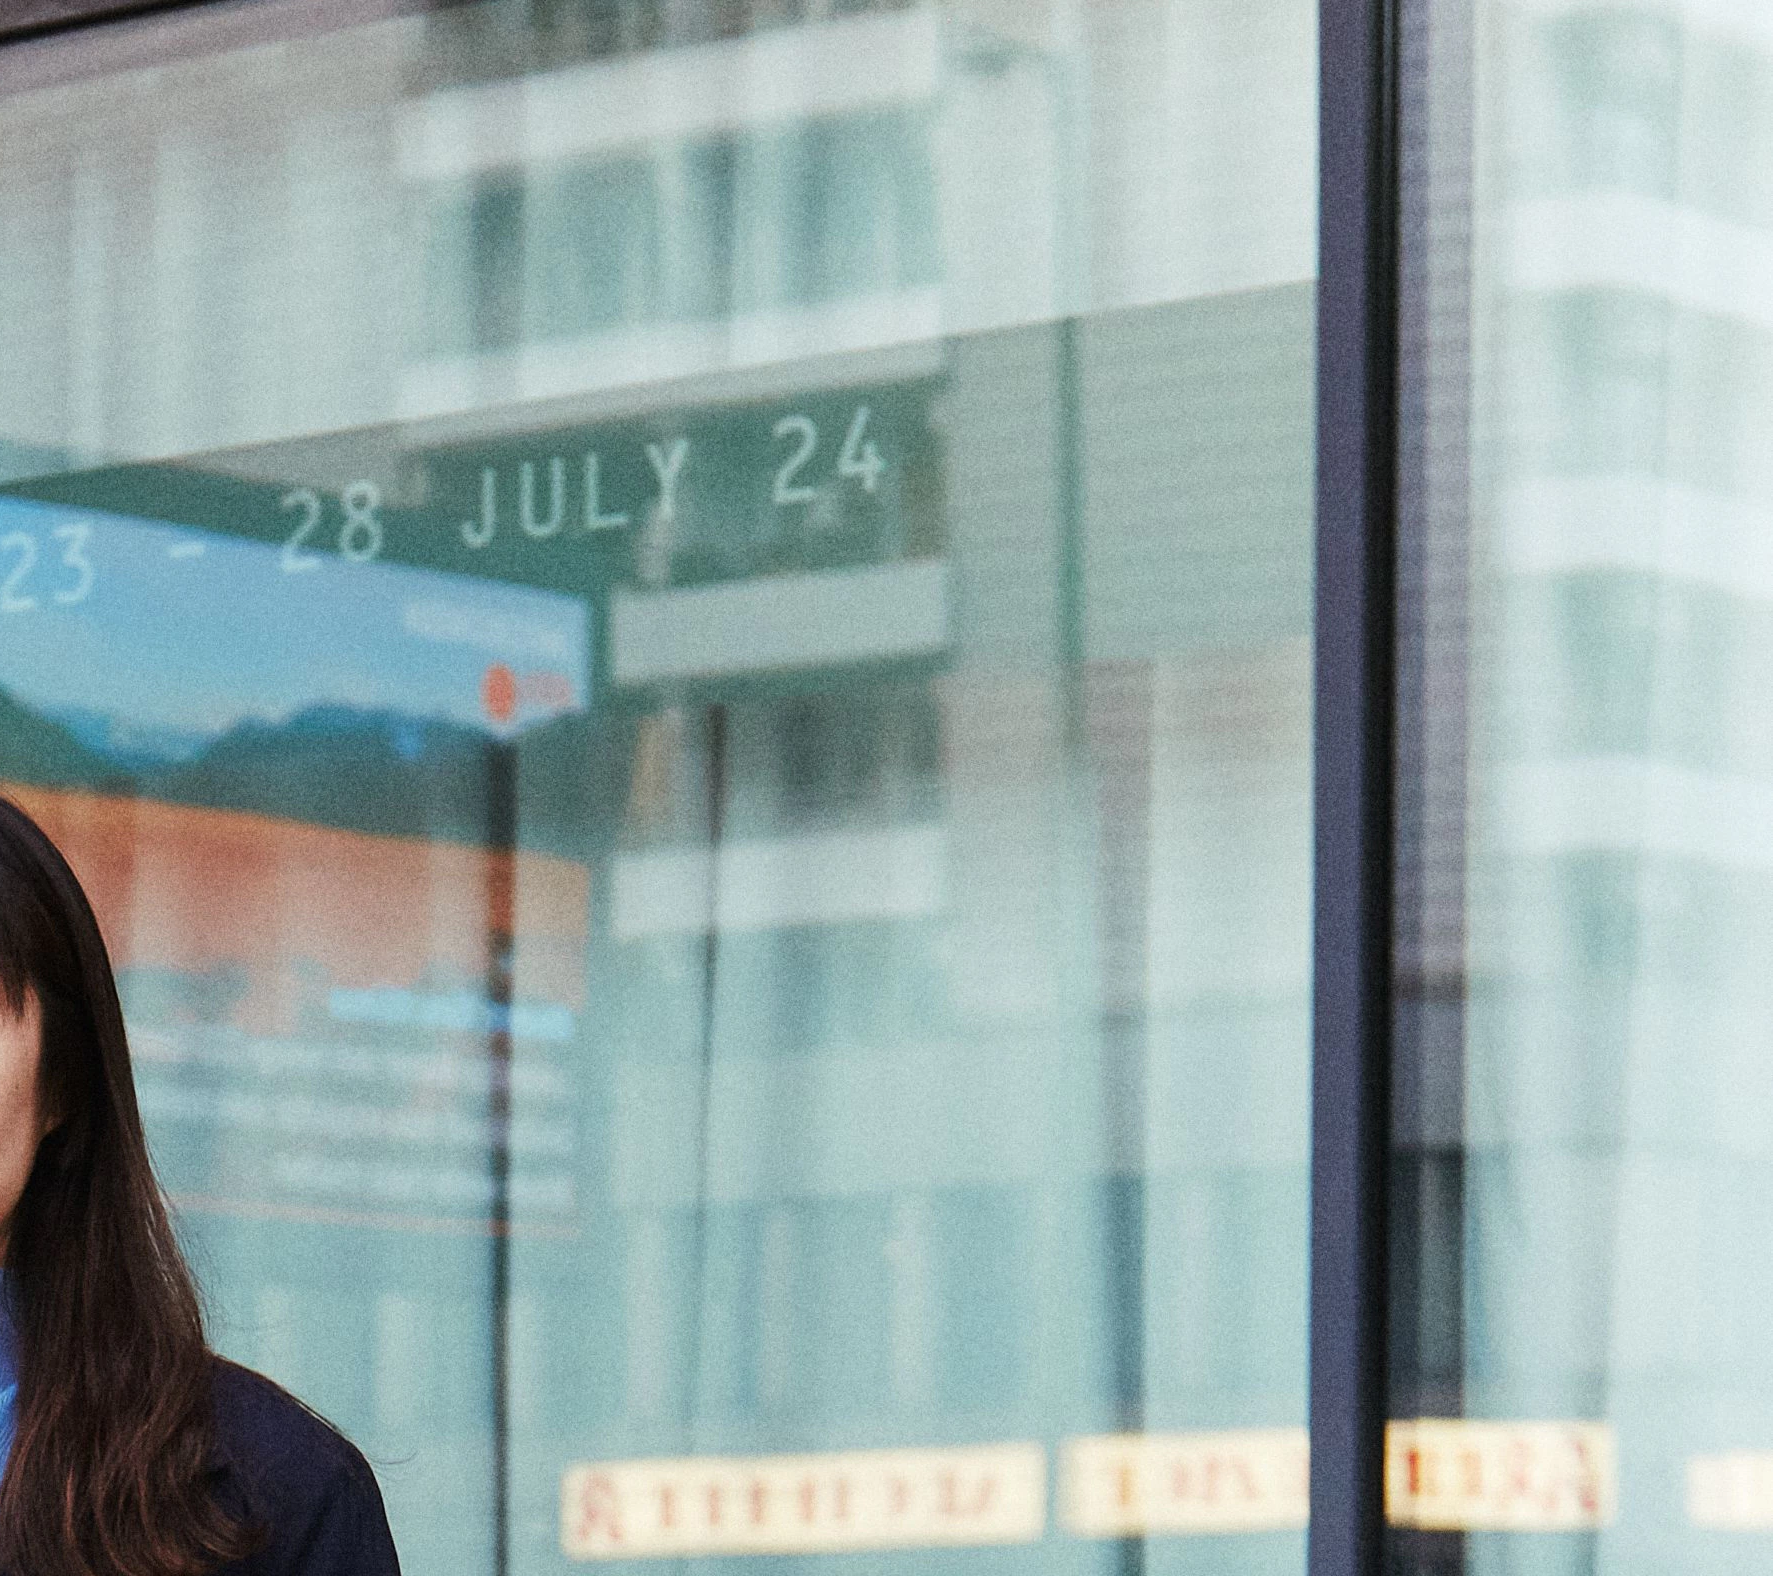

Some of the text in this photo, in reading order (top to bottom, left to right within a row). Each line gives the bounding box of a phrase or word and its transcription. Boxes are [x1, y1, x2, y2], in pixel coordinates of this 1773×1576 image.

[0, 521, 95, 612] 23
[280, 480, 384, 572] 28
[462, 439, 690, 548] JULY
[772, 406, 886, 505] 24
